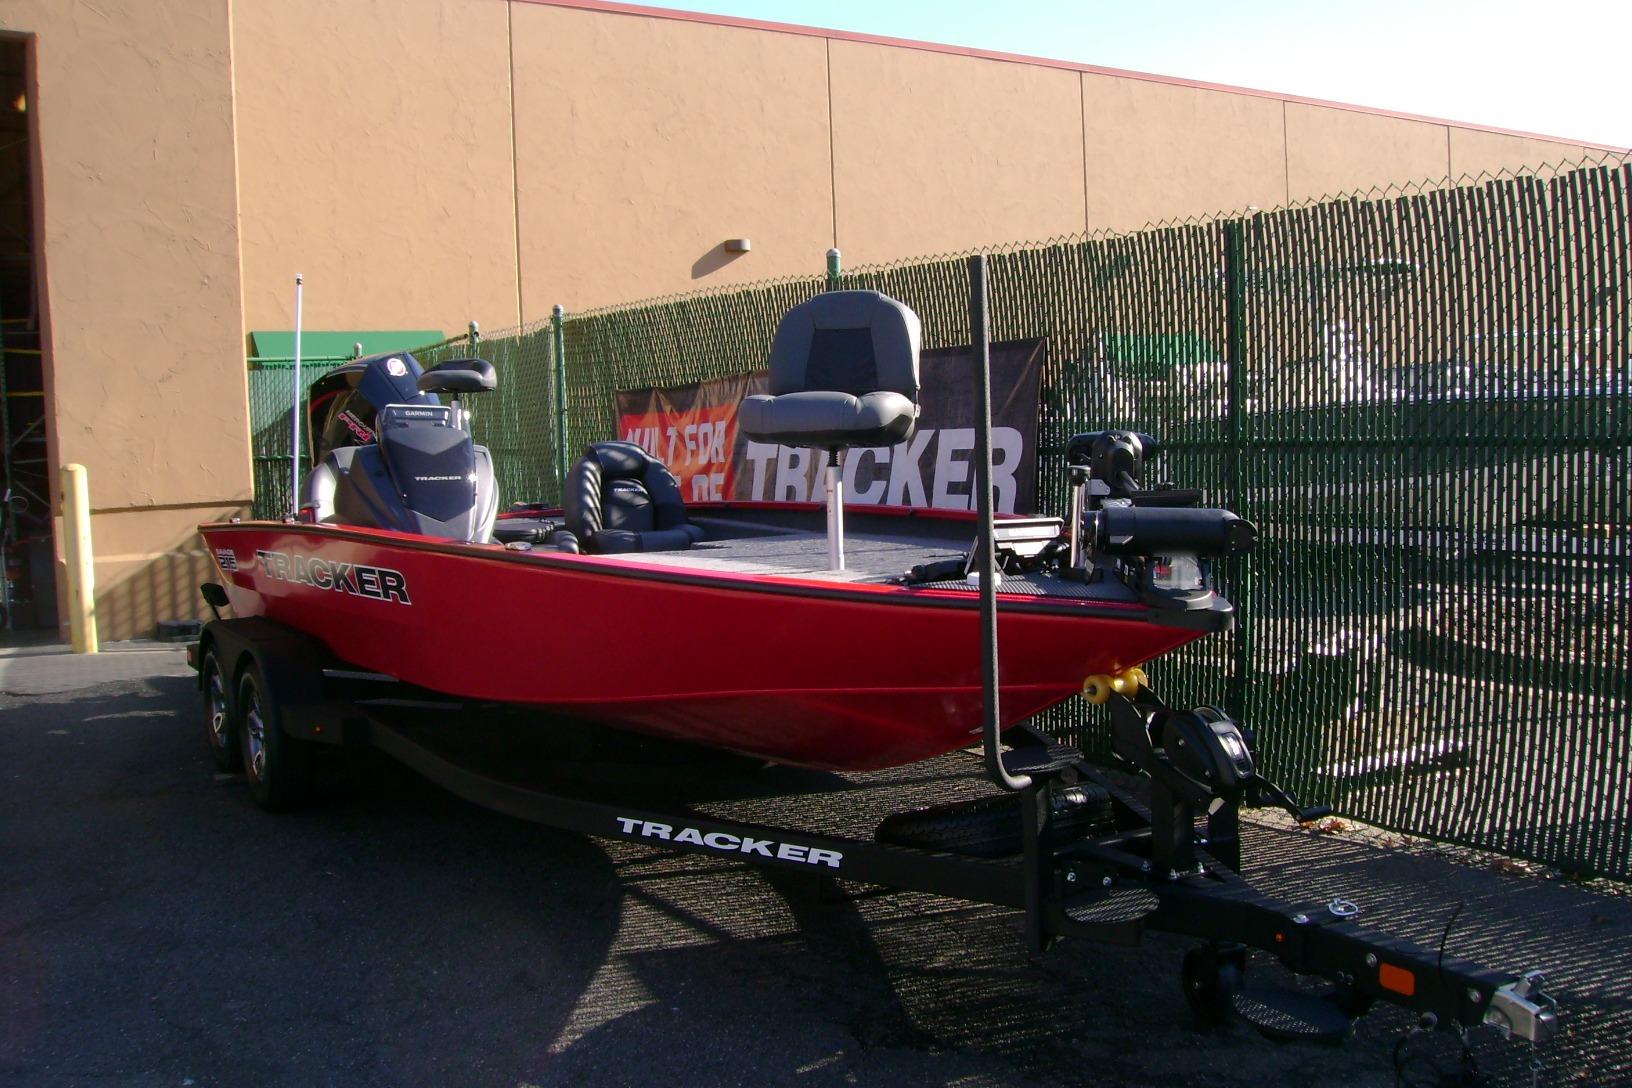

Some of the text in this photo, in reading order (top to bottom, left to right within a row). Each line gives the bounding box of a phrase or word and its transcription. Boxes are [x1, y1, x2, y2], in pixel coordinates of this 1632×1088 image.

[685, 421, 726, 466] FOR
[256, 550, 412, 605] TRACKER
[616, 817, 844, 868] TRACKER
